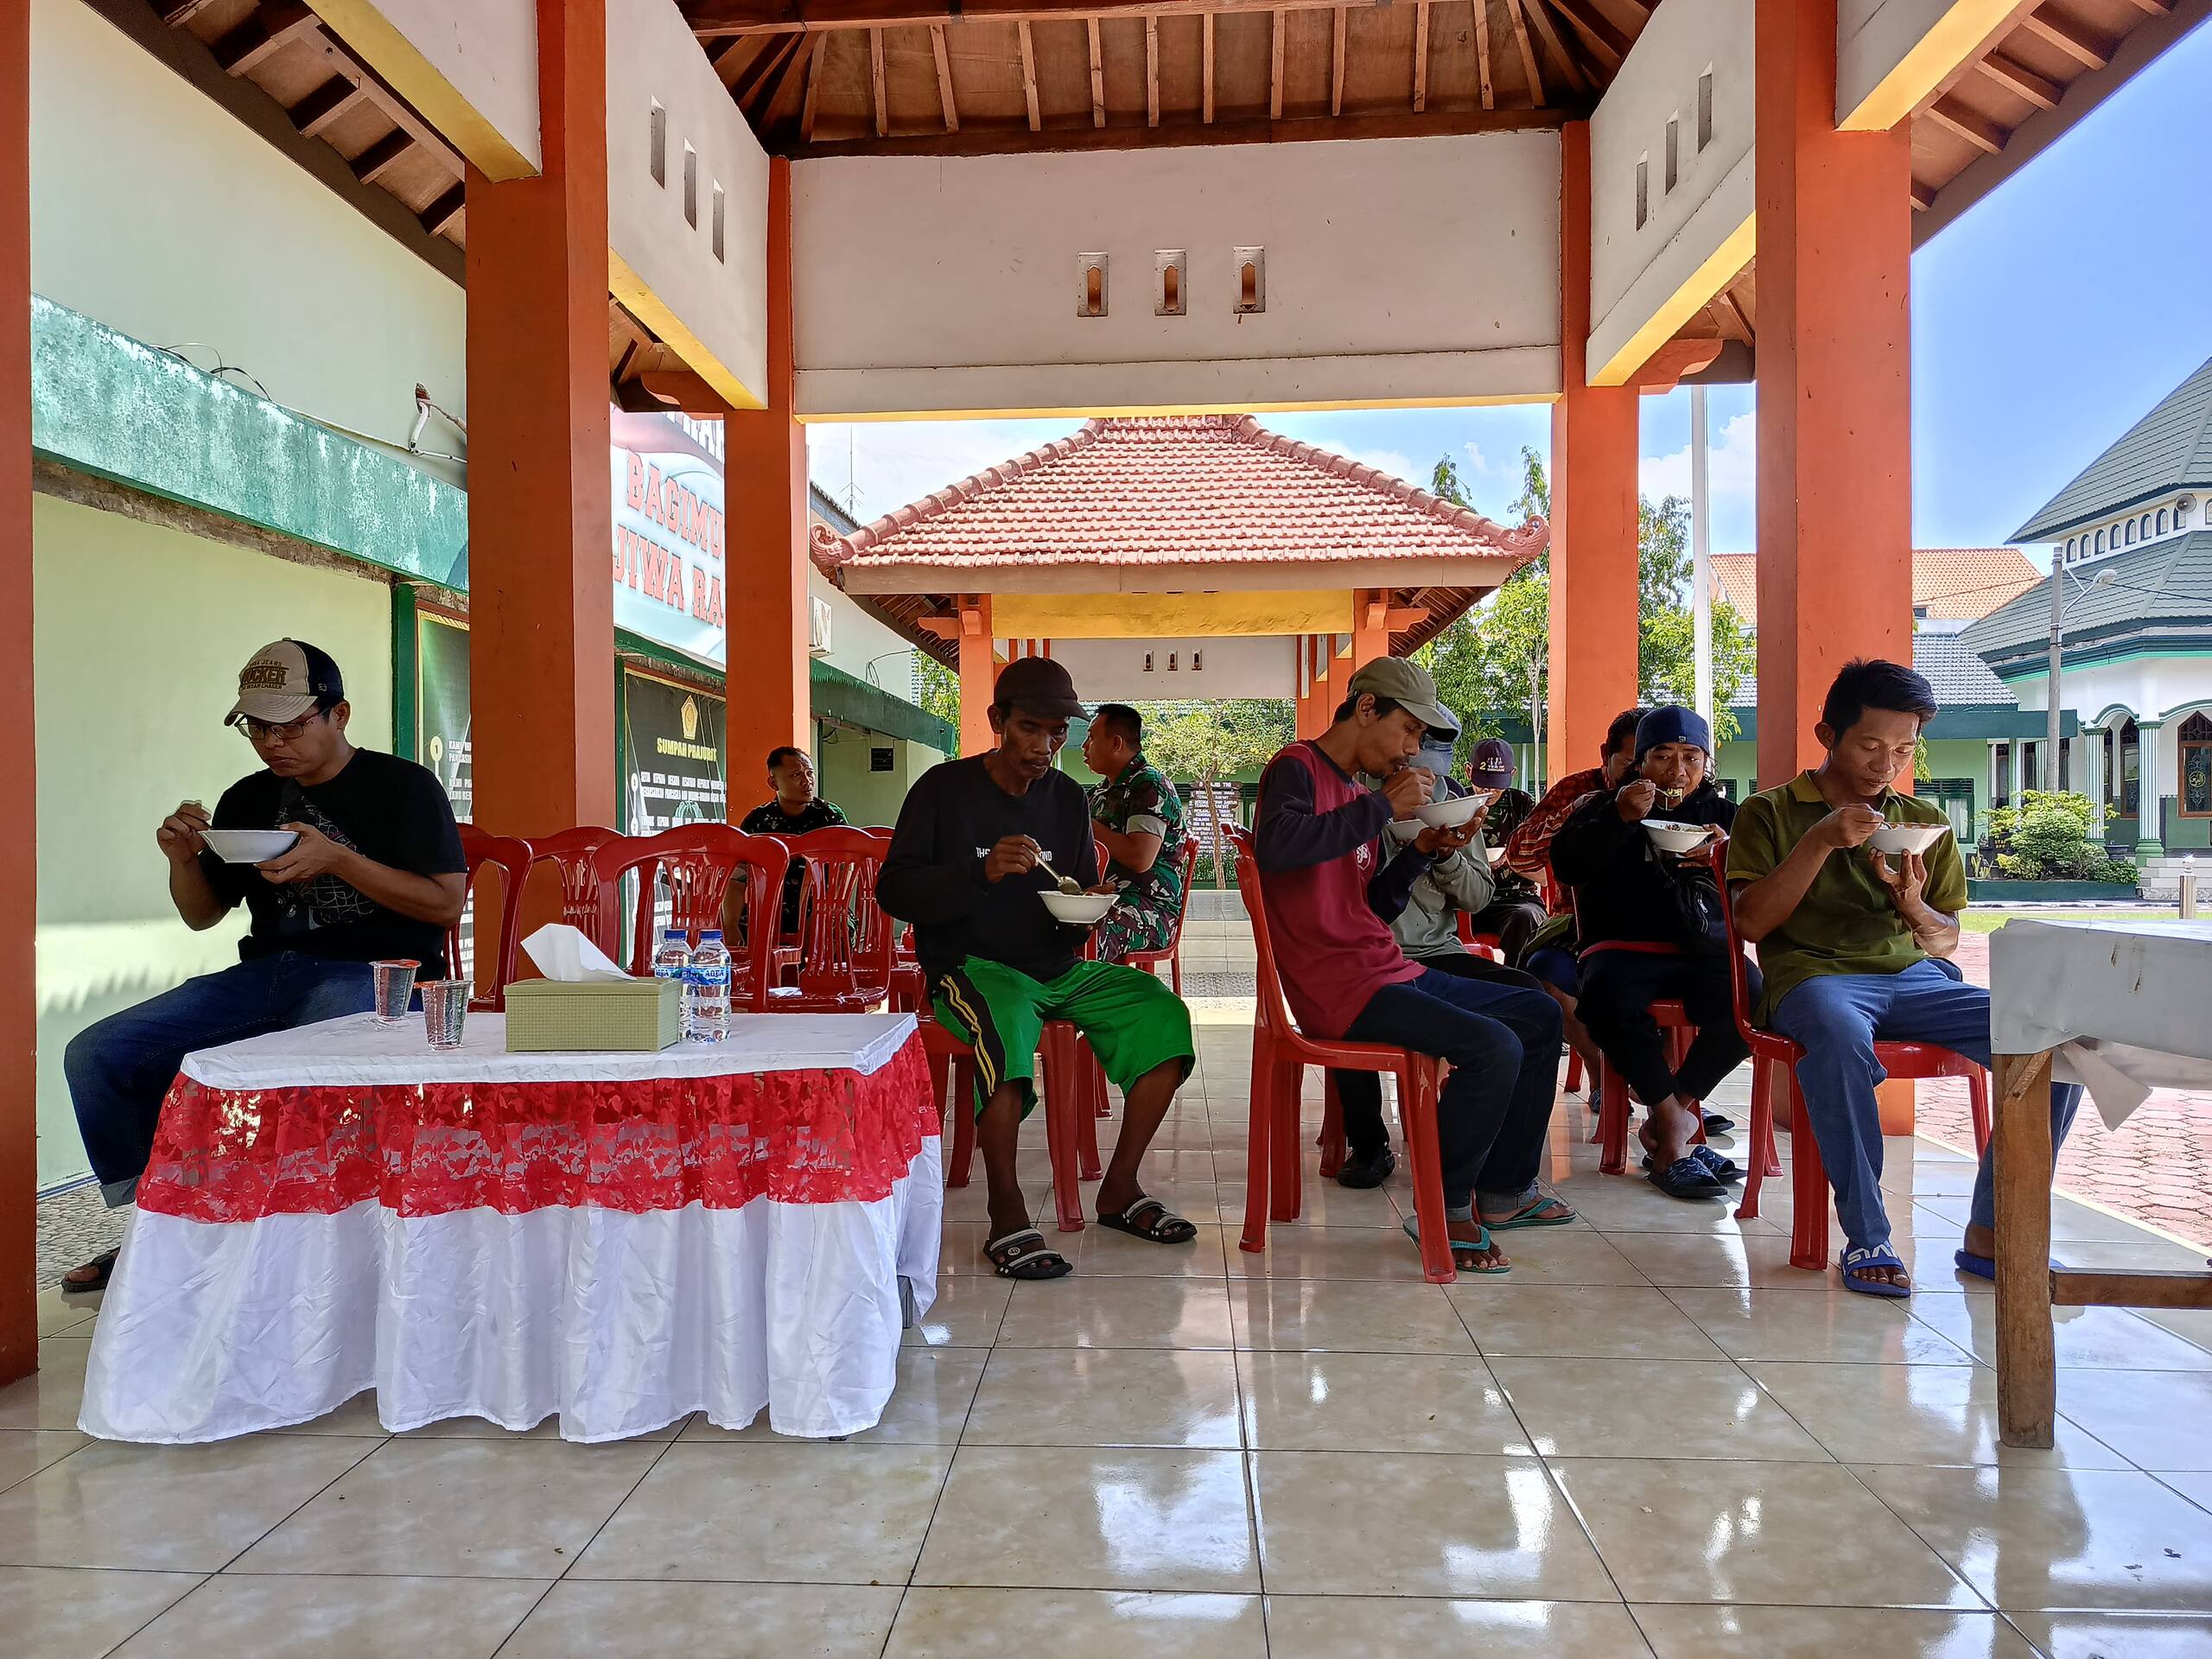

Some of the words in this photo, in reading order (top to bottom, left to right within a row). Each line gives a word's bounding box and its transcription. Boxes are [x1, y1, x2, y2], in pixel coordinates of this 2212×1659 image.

[626, 448, 723, 560] BAGIMU
[613, 524, 684, 612] JIWA
[657, 737, 688, 758] SUMPAH
[688, 744, 717, 761] PRAJURIT
[705, 969, 725, 978] AQUA
